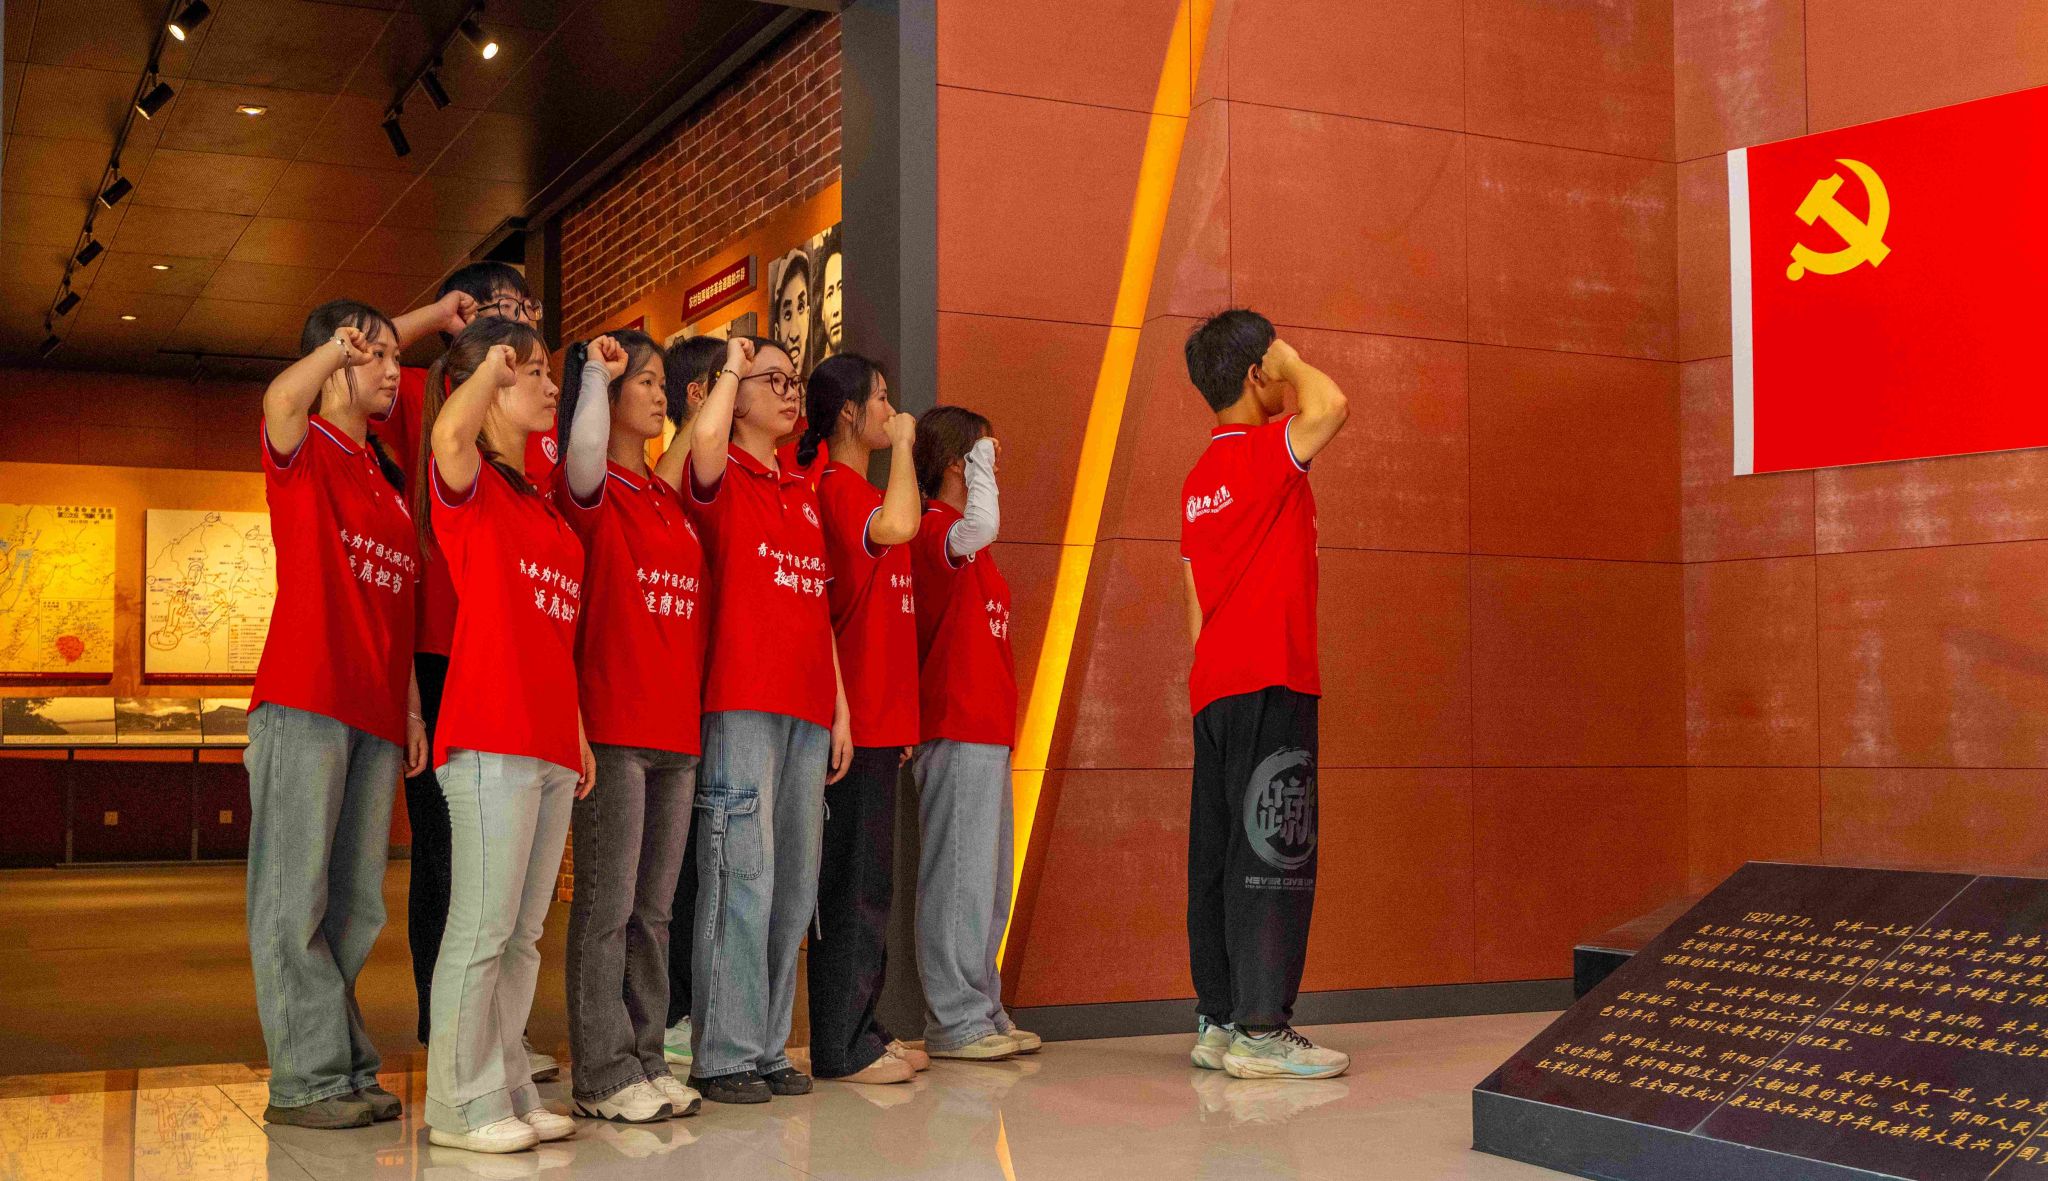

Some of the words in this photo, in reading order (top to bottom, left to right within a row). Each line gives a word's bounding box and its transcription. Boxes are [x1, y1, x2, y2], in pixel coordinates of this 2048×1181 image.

[1245, 876, 1281, 886] NEVER
[1742, 912, 2048, 950] 1921年7月，中共一大在上海召开，宣告
